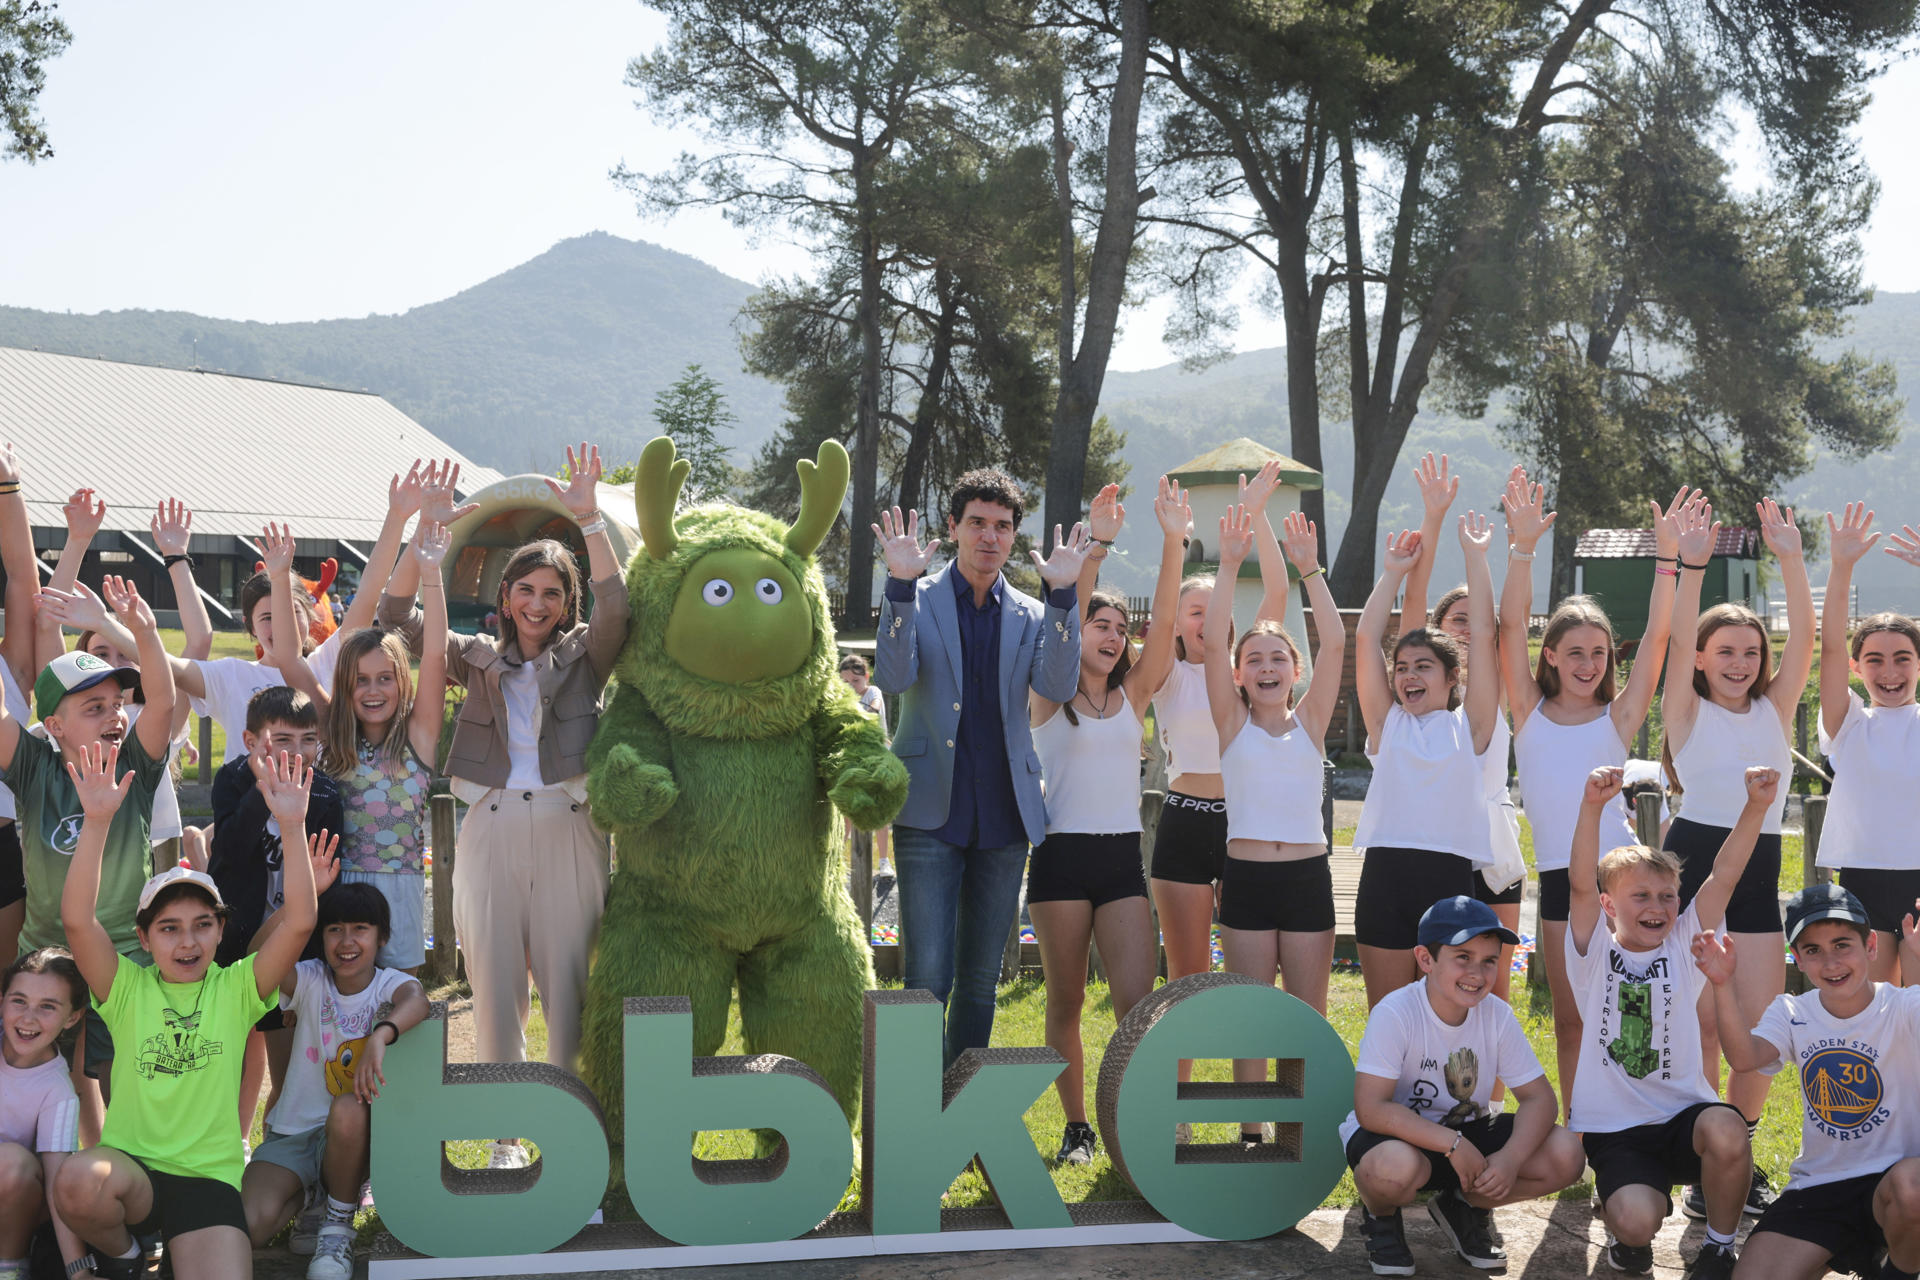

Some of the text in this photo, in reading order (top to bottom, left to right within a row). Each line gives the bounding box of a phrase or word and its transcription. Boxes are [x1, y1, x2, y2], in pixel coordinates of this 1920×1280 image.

[1181, 798, 1226, 813] PRO
[1662, 984, 1672, 1081] EXPLORER
[1800, 1039, 1846, 1059] GOLDEN
[1423, 1057, 1438, 1072] AM
[1838, 1063, 1868, 1085] 30
[1807, 1105, 1891, 1142] WARRIORS
